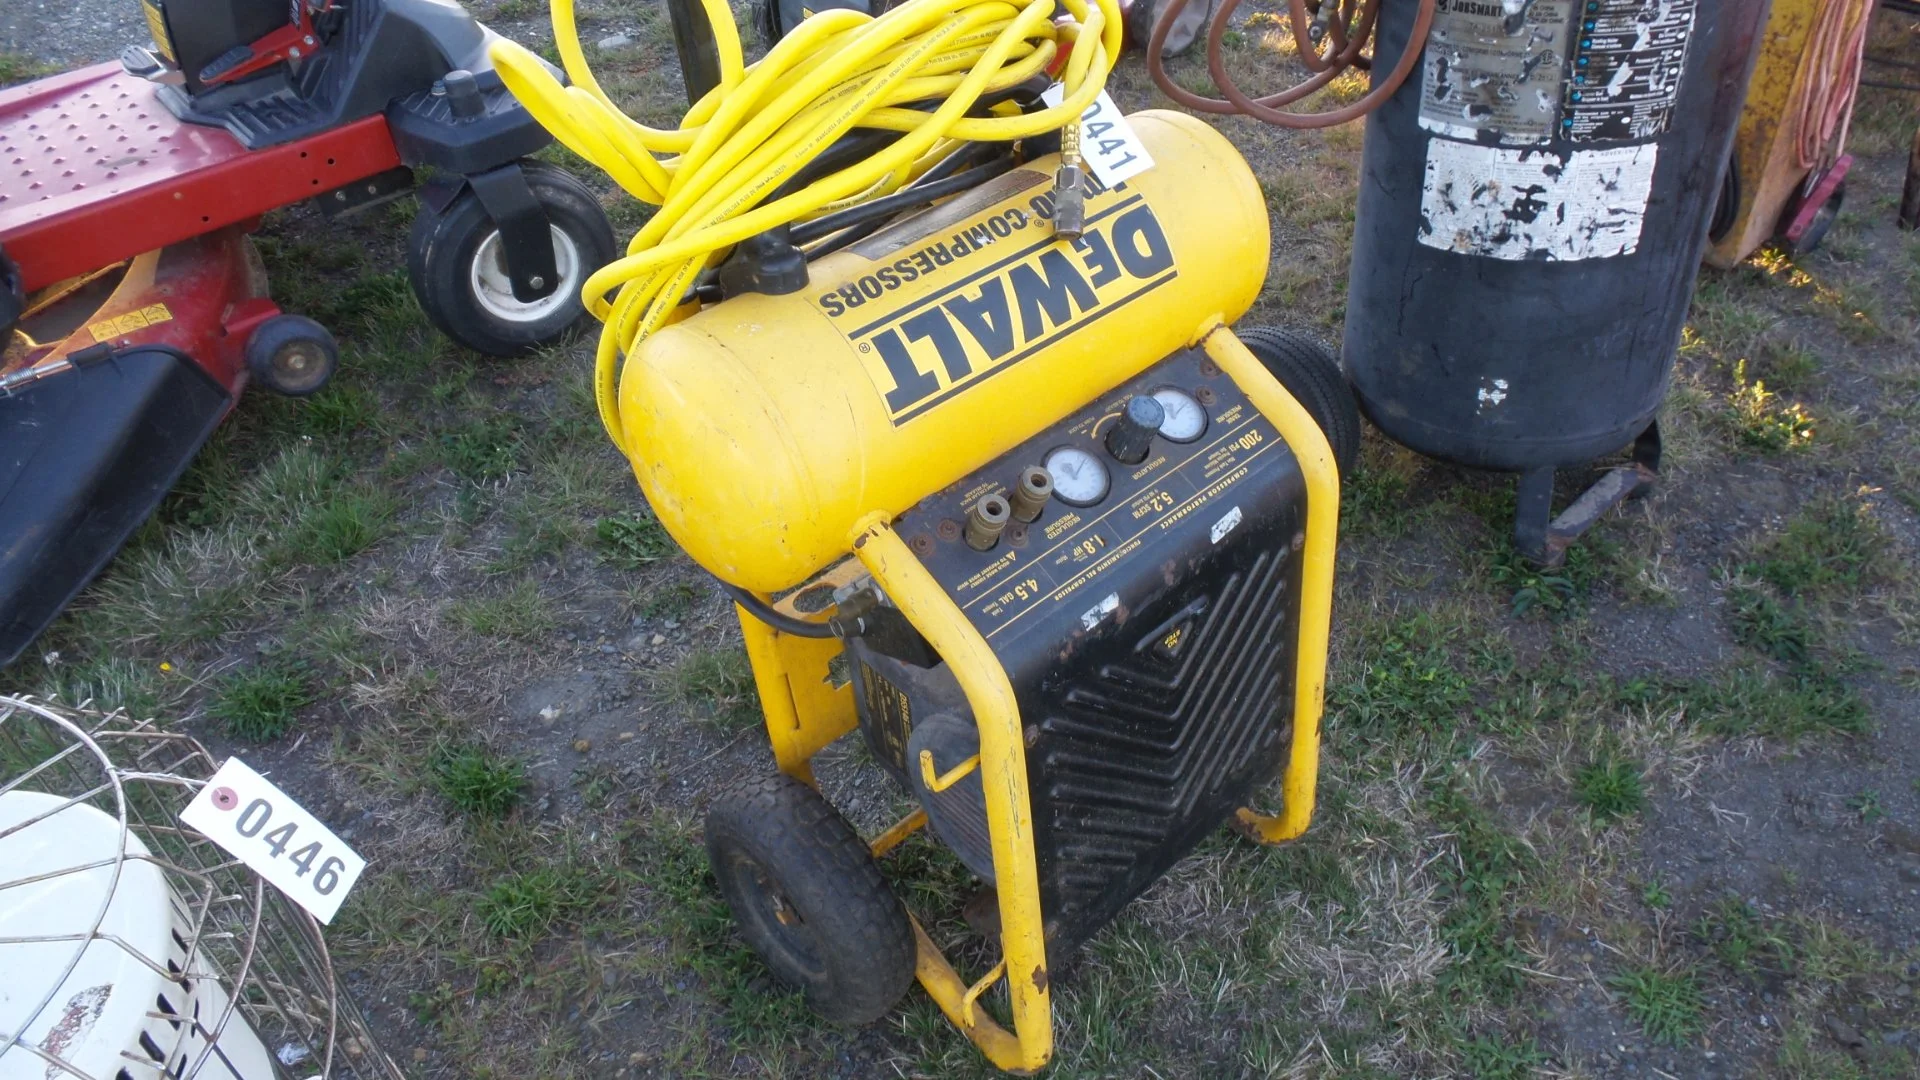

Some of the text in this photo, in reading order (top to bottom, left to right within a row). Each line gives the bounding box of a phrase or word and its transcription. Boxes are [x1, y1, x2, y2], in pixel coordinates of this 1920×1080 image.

[818, 207, 1027, 319] COMPRESSORS
[1228, 429, 1262, 452] 200 PSI
[1131, 456, 1165, 480] REGULATOR
[1206, 466, 1248, 496] COMPRESSOR
[1132, 490, 1173, 519] 5.2 SCFM
[1159, 495, 1206, 529] PERFORMANCE
[1043, 511, 1074, 533] PRESSURE
[1046, 515, 1080, 539] REGULATED
[1071, 545, 1082, 555] HP
[1081, 533, 1104, 554] 1.8
[998, 577, 1039, 605] 4.5 GAL
[235, 797, 347, 896] 0446
